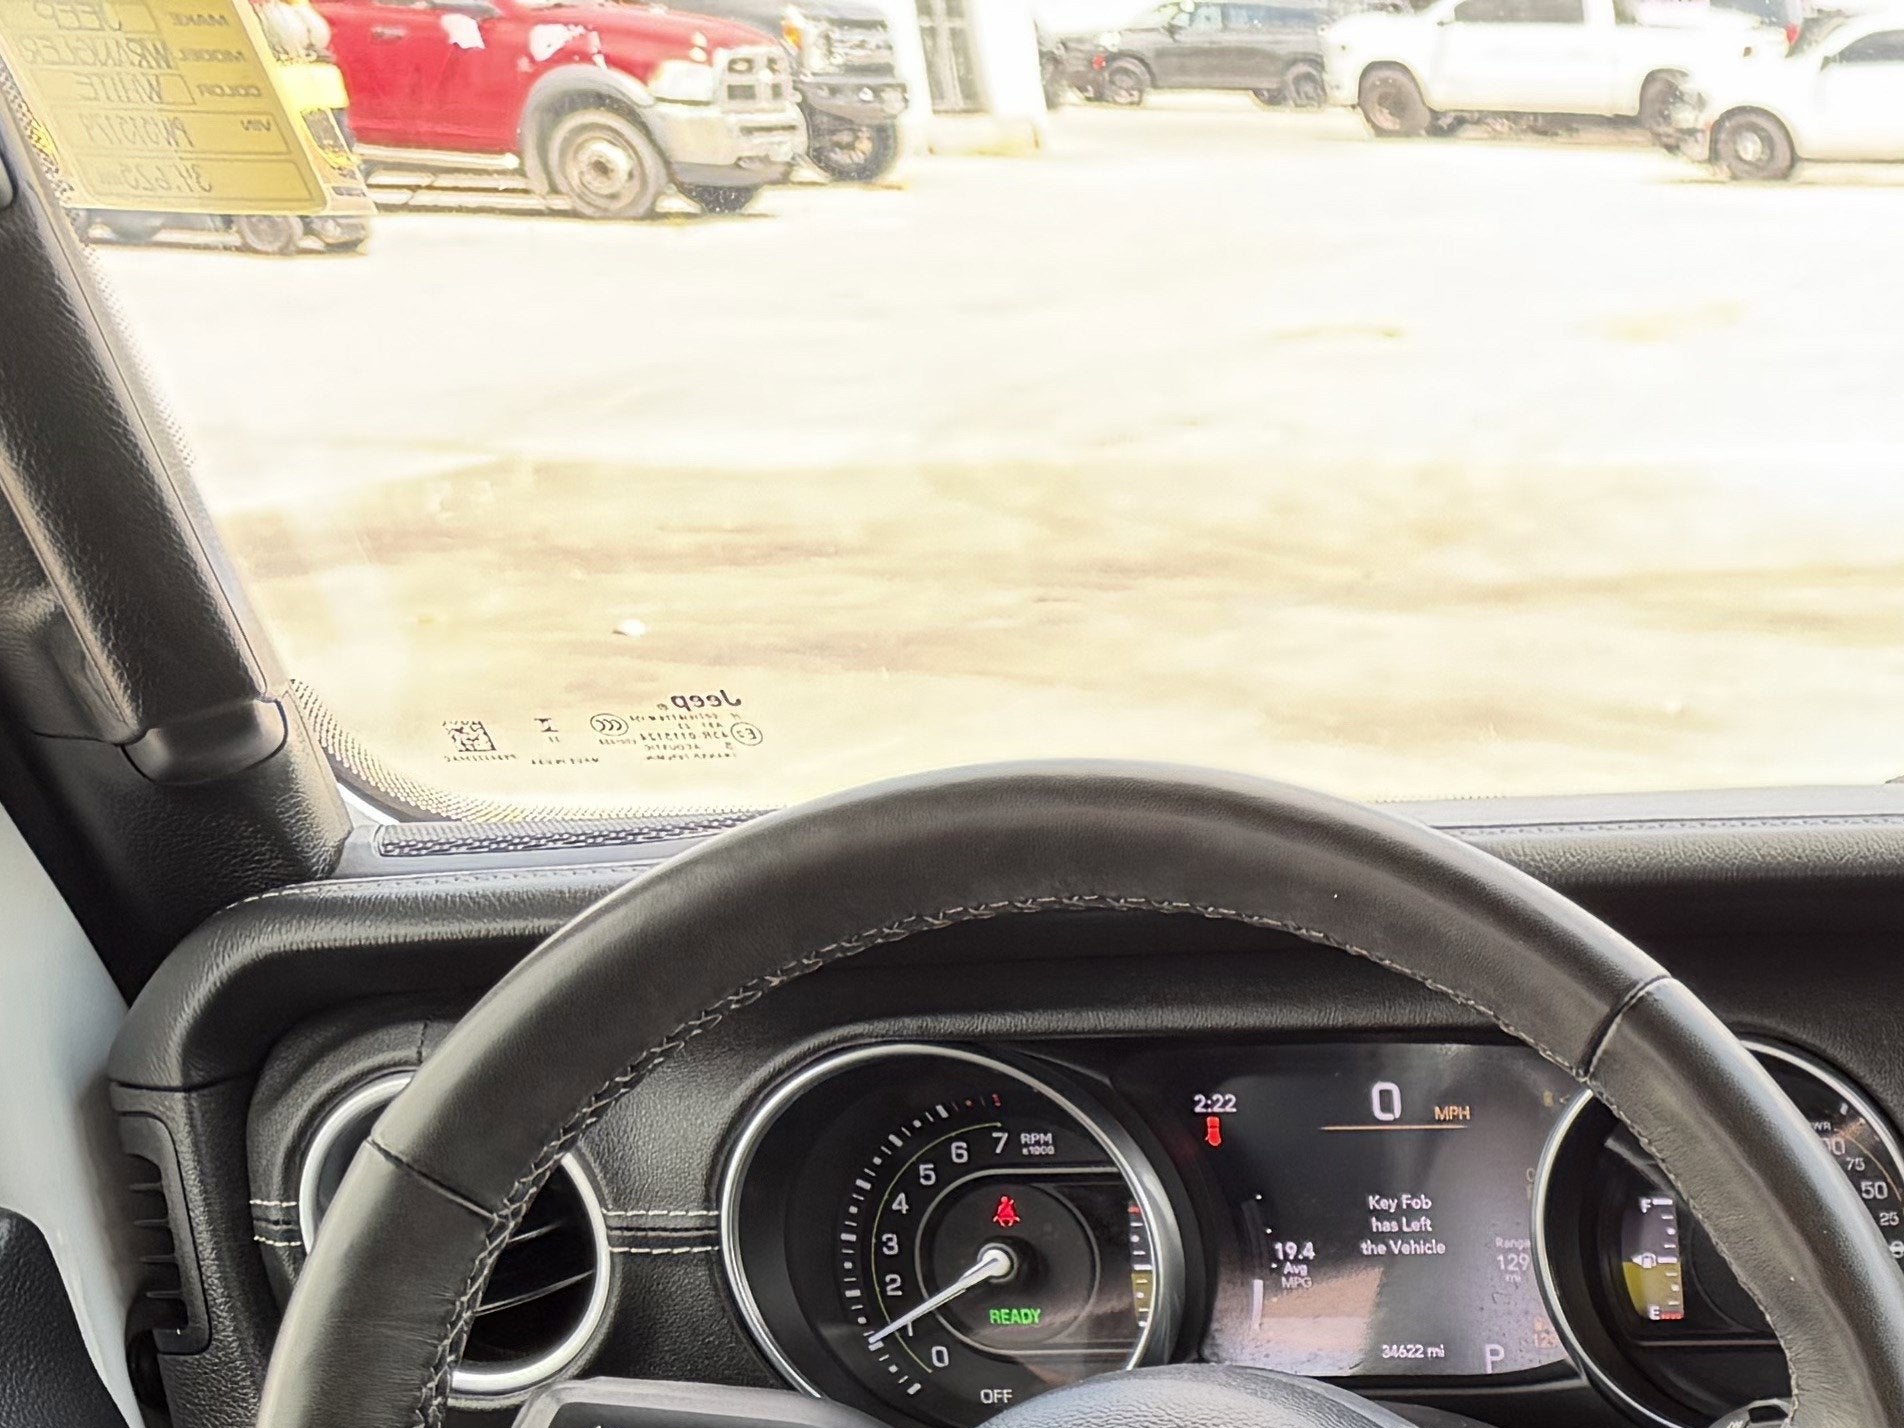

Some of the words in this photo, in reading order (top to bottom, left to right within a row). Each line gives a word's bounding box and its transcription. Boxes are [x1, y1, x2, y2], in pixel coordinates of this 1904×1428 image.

[1193, 1093, 1237, 1112] 2:22
[1371, 1081, 1401, 1121] 0
[1434, 1105, 1471, 1121] MPH
[992, 1132, 1008, 1154] 7
[1021, 1133, 1053, 1144] RPM
[951, 1142, 968, 1163] 6
[1846, 1157, 1866, 1171] 75
[919, 1164, 936, 1186] 5
[1861, 1181, 1888, 1199] 50
[892, 1193, 909, 1214] 4
[1369, 1195, 1398, 1212] Key
[1401, 1194, 1432, 1210] Fob
[1371, 1217, 1399, 1232] has
[1402, 1217, 1432, 1233] Left
[1879, 1212, 1900, 1226] 25
[882, 1233, 899, 1255] 3
[1274, 1241, 1315, 1259] 19.4
[1360, 1240, 1387, 1256] the
[1389, 1239, 1446, 1255] Vehicle
[1283, 1262, 1307, 1277] Avg
[1496, 1254, 1530, 1271] 129
[885, 1274, 903, 1296] 2
[1281, 1277, 1312, 1289] MPG
[989, 1309, 1041, 1325] READY
[932, 1346, 949, 1367] 0
[1427, 1343, 1445, 1358] mi
[1485, 1344, 1505, 1374] P
[980, 1389, 1012, 1404] OFF
